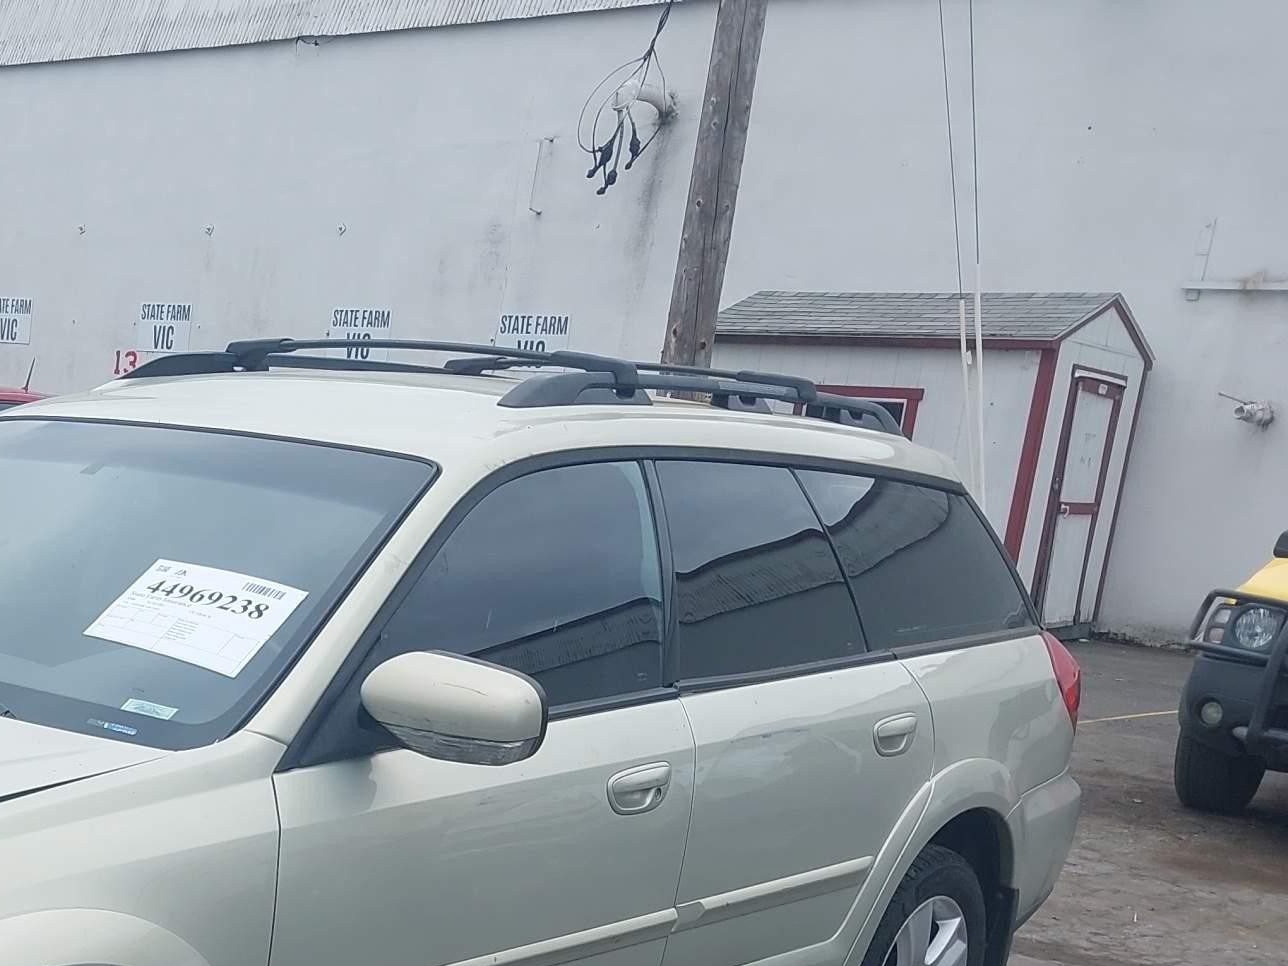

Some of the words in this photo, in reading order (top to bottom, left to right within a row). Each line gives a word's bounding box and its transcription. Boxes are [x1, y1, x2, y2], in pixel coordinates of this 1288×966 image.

[10, 299, 32, 315] FARM
[141, 304, 165, 320] STATE
[166, 305, 191, 321] FARM
[0, 318, 18, 341] VIC
[332, 309, 359, 328] STATE
[361, 310, 390, 329] FARM
[500, 315, 533, 335] STATE
[534, 316, 569, 335] FARM
[153, 325, 174, 350] VIC
[345, 332, 371, 360] VIC
[146, 580, 270, 619] 44969238
